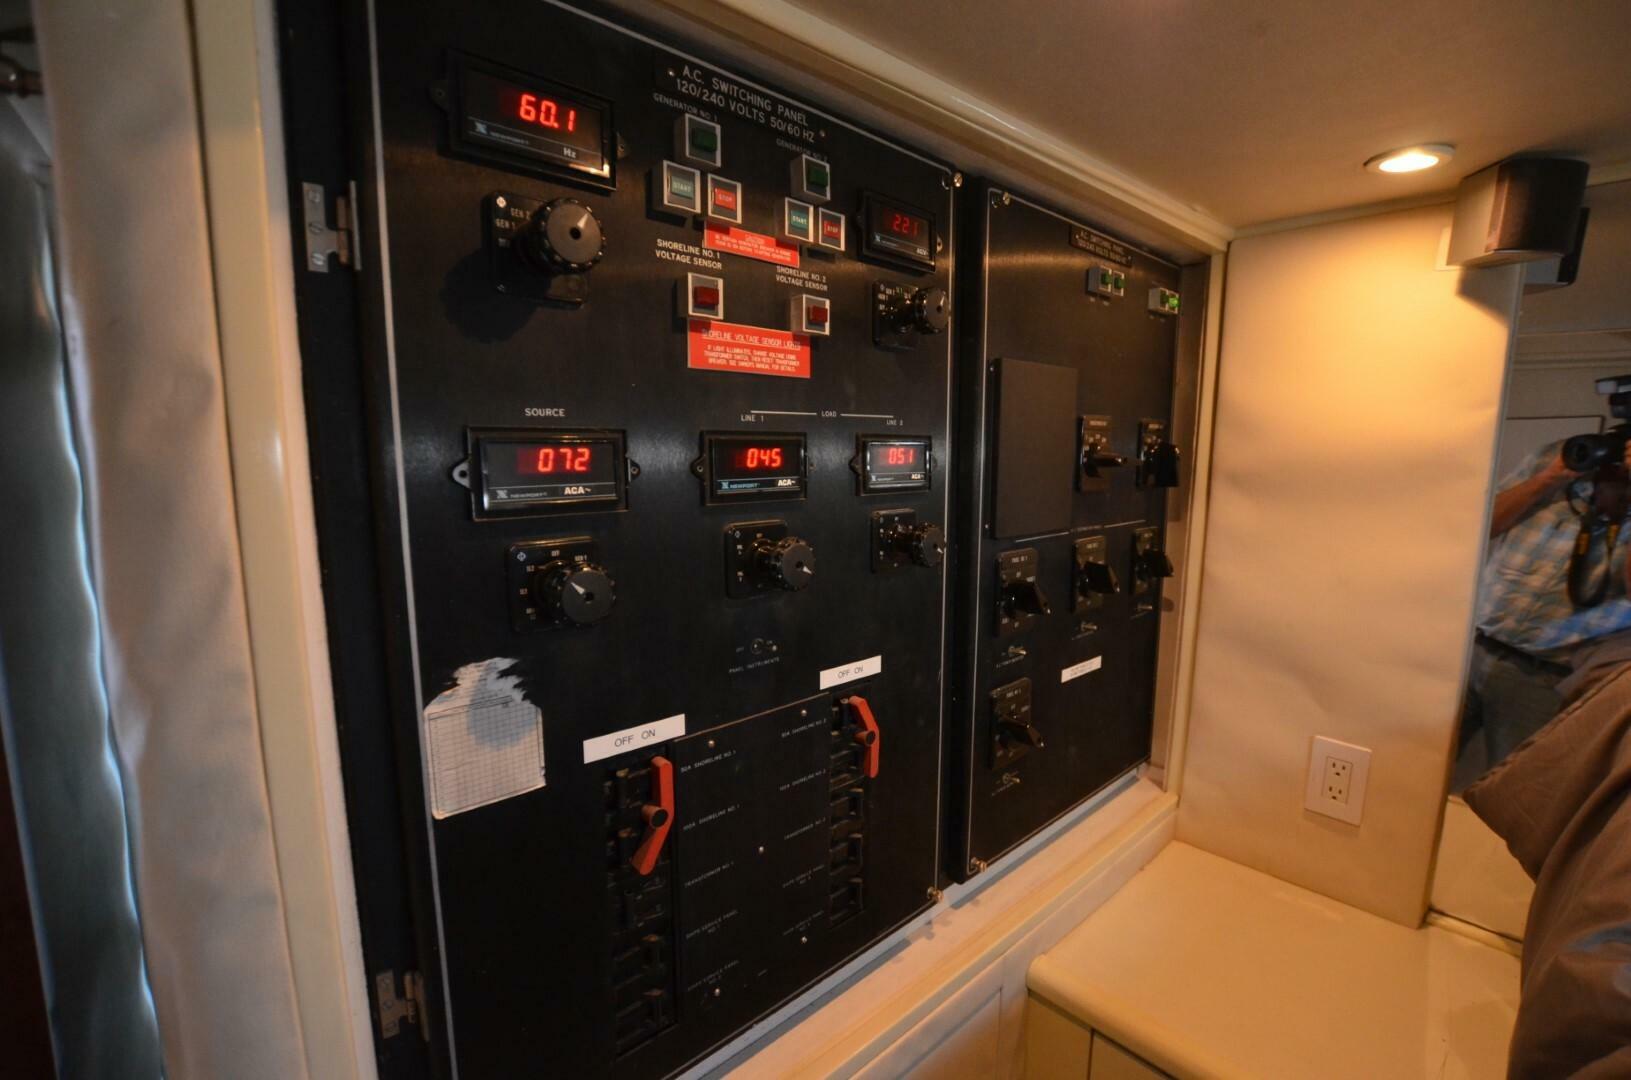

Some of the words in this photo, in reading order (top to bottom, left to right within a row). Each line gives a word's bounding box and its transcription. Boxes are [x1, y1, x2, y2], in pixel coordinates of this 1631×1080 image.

[653, 92, 699, 115] GENERATOR
[682, 65, 705, 85] A.C.
[712, 77, 772, 112] SWITCHING
[778, 106, 809, 126] PANEL
[519, 92, 577, 134] 60.1
[676, 79, 726, 108] 120/240
[729, 100, 766, 124] VOLTS
[770, 116, 800, 138] 50/60
[802, 130, 816, 144] HZ
[563, 146, 577, 159] Hz
[673, 182, 692, 194] START
[792, 213, 807, 225] START
[827, 224, 839, 234] STOP
[657, 238, 700, 256] SHORELINE
[702, 248, 716, 259] NO.
[716, 252, 721, 260] 1
[655, 250, 692, 264] VOLTAGE
[693, 257, 722, 271] SENSOR
[776, 265, 810, 281] SHORELINE
[775, 275, 804, 288] VOLTAGE
[805, 281, 828, 292] SENSOR
[702, 328, 732, 341] SHORELINE
[735, 333, 759, 344] VOLTAGE
[761, 336, 782, 347] SENSOR
[783, 340, 801, 349] LIGHTS
[524, 408, 565, 417] SOURCE
[740, 414, 756, 423] LINE
[886, 419, 897, 427] LINE
[538, 448, 590, 472] 072
[746, 448, 782, 469] 045
[888, 448, 914, 465] 051
[837, 669, 850, 679] OFF
[854, 665, 864, 675] ON
[614, 734, 635, 748] OFF
[641, 728, 656, 740] ON
